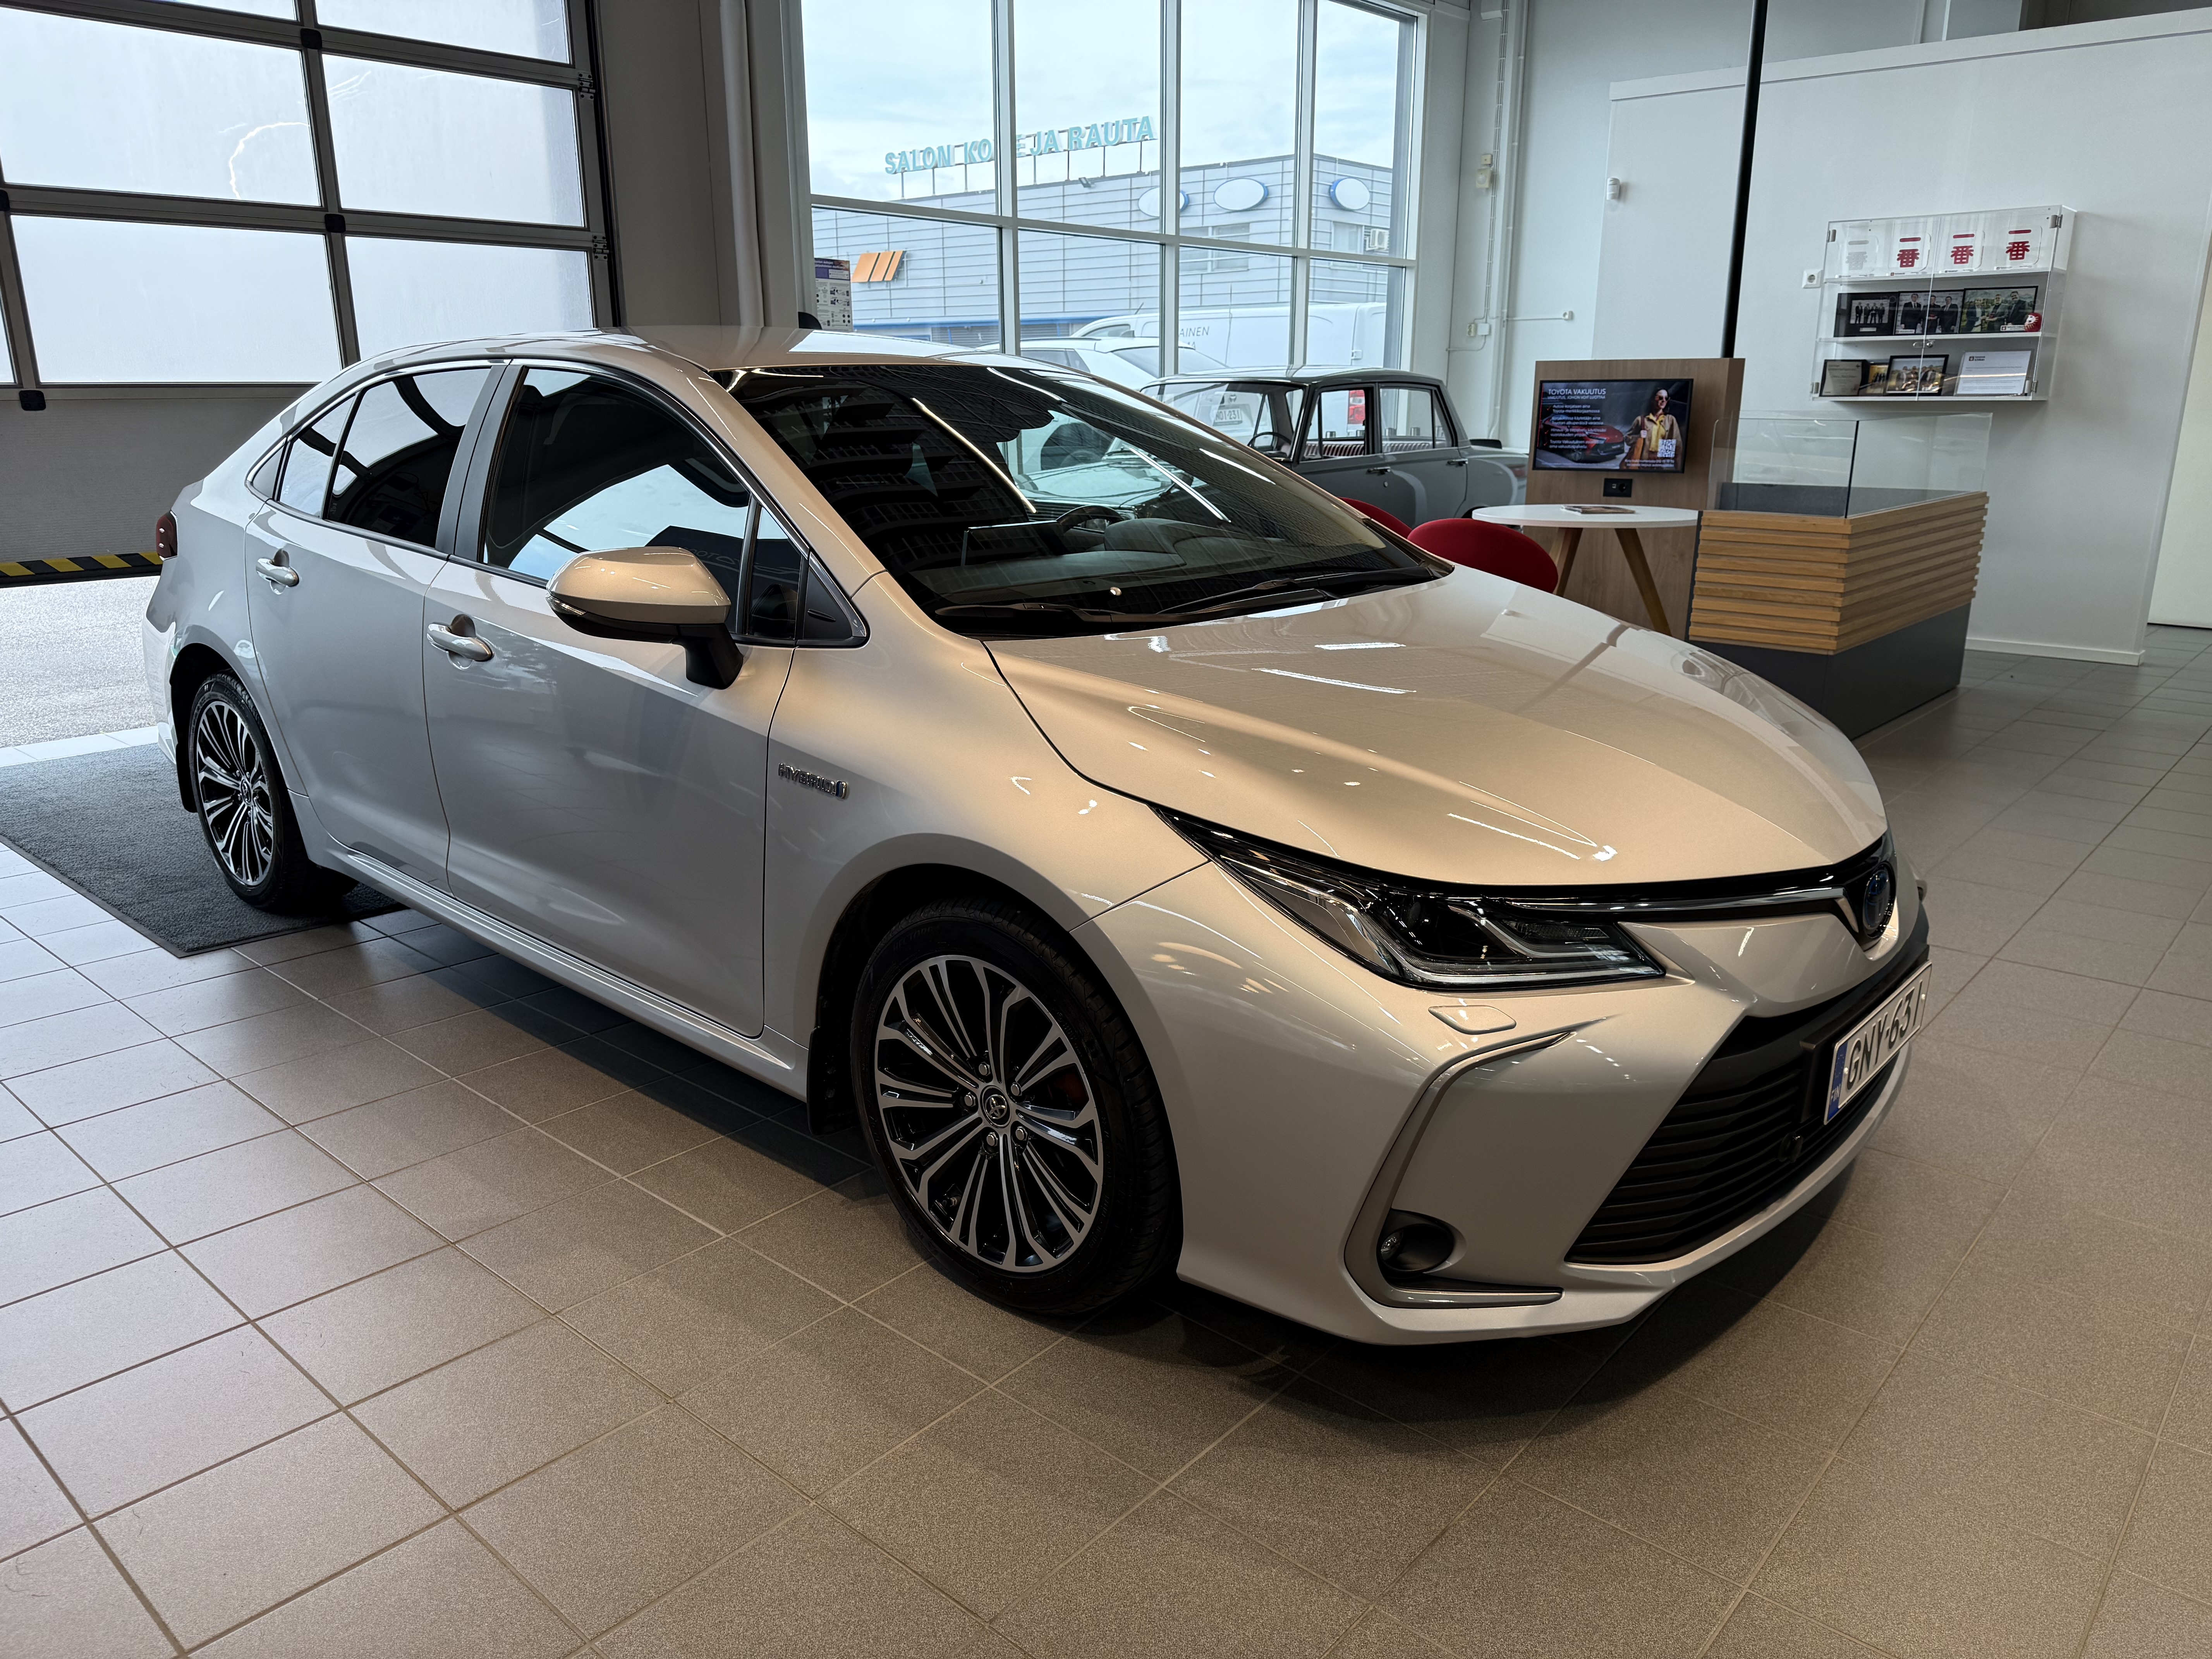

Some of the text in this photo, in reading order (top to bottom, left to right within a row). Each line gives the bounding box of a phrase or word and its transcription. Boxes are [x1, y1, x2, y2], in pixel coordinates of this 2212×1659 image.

[885, 116, 1156, 174] SALON KOE JA RAUTA
[2006, 229, 2031, 260] 一番
[1180, 326, 1210, 337] AINEN
[778, 763, 836, 796] HYBRID
[1847, 980, 1923, 1090] GNY-631
[1831, 1084, 1841, 1103] FIN
